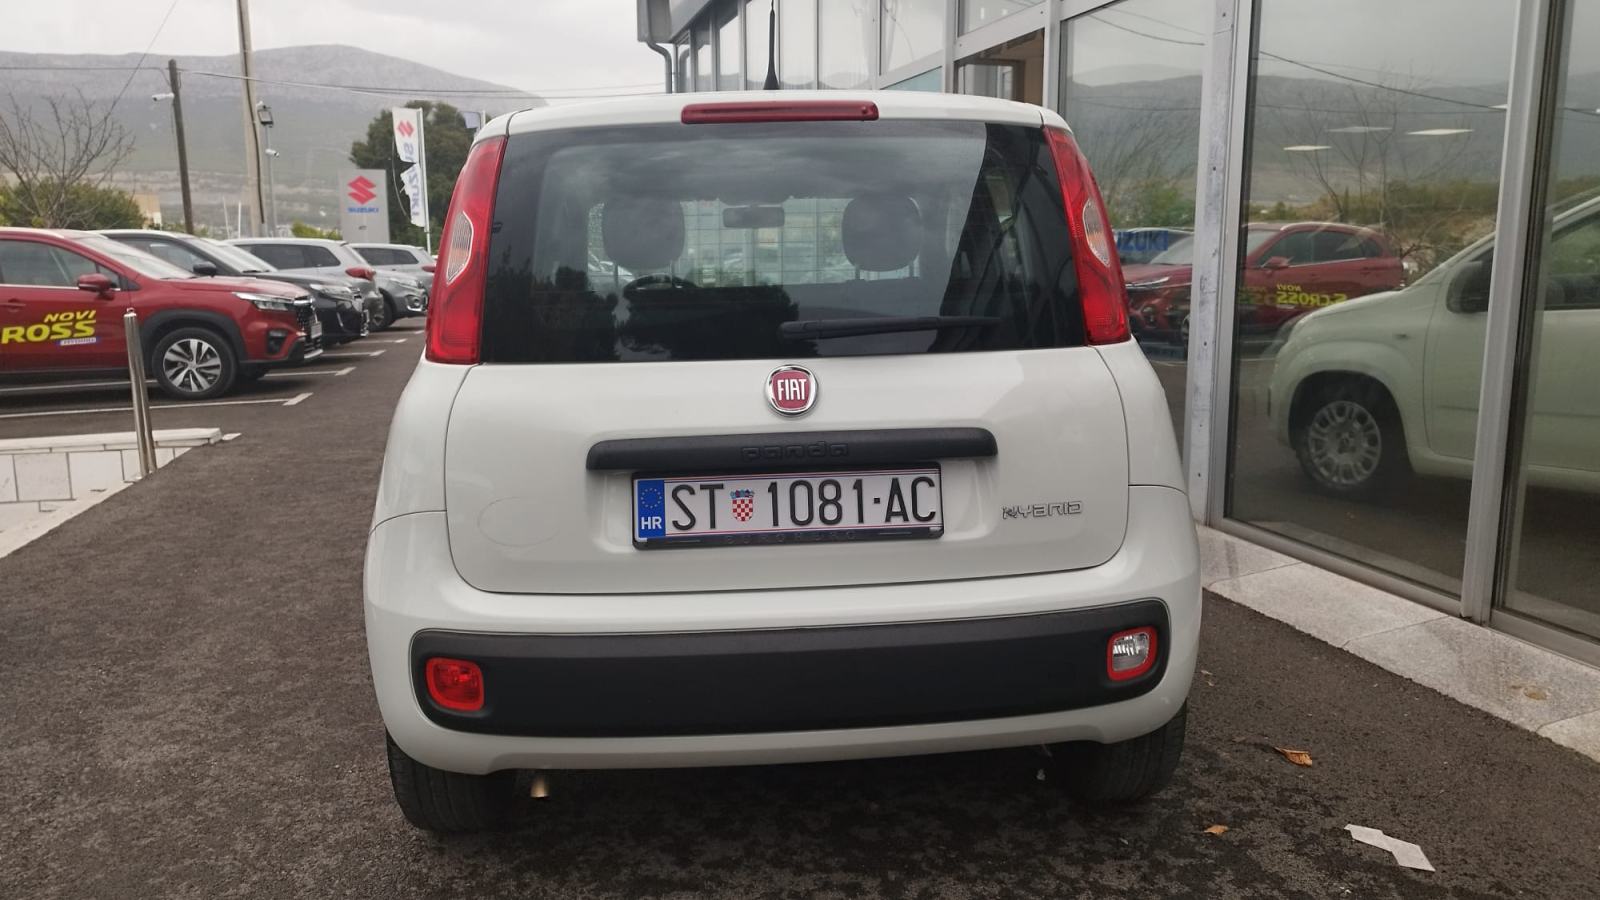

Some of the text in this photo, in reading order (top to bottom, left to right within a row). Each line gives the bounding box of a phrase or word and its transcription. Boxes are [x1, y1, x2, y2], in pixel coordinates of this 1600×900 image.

[43, 309, 97, 323] NOVI
[777, 378, 807, 401] FIAT
[741, 441, 849, 463] panda
[671, 483, 724, 531] ST
[640, 516, 663, 530] HR
